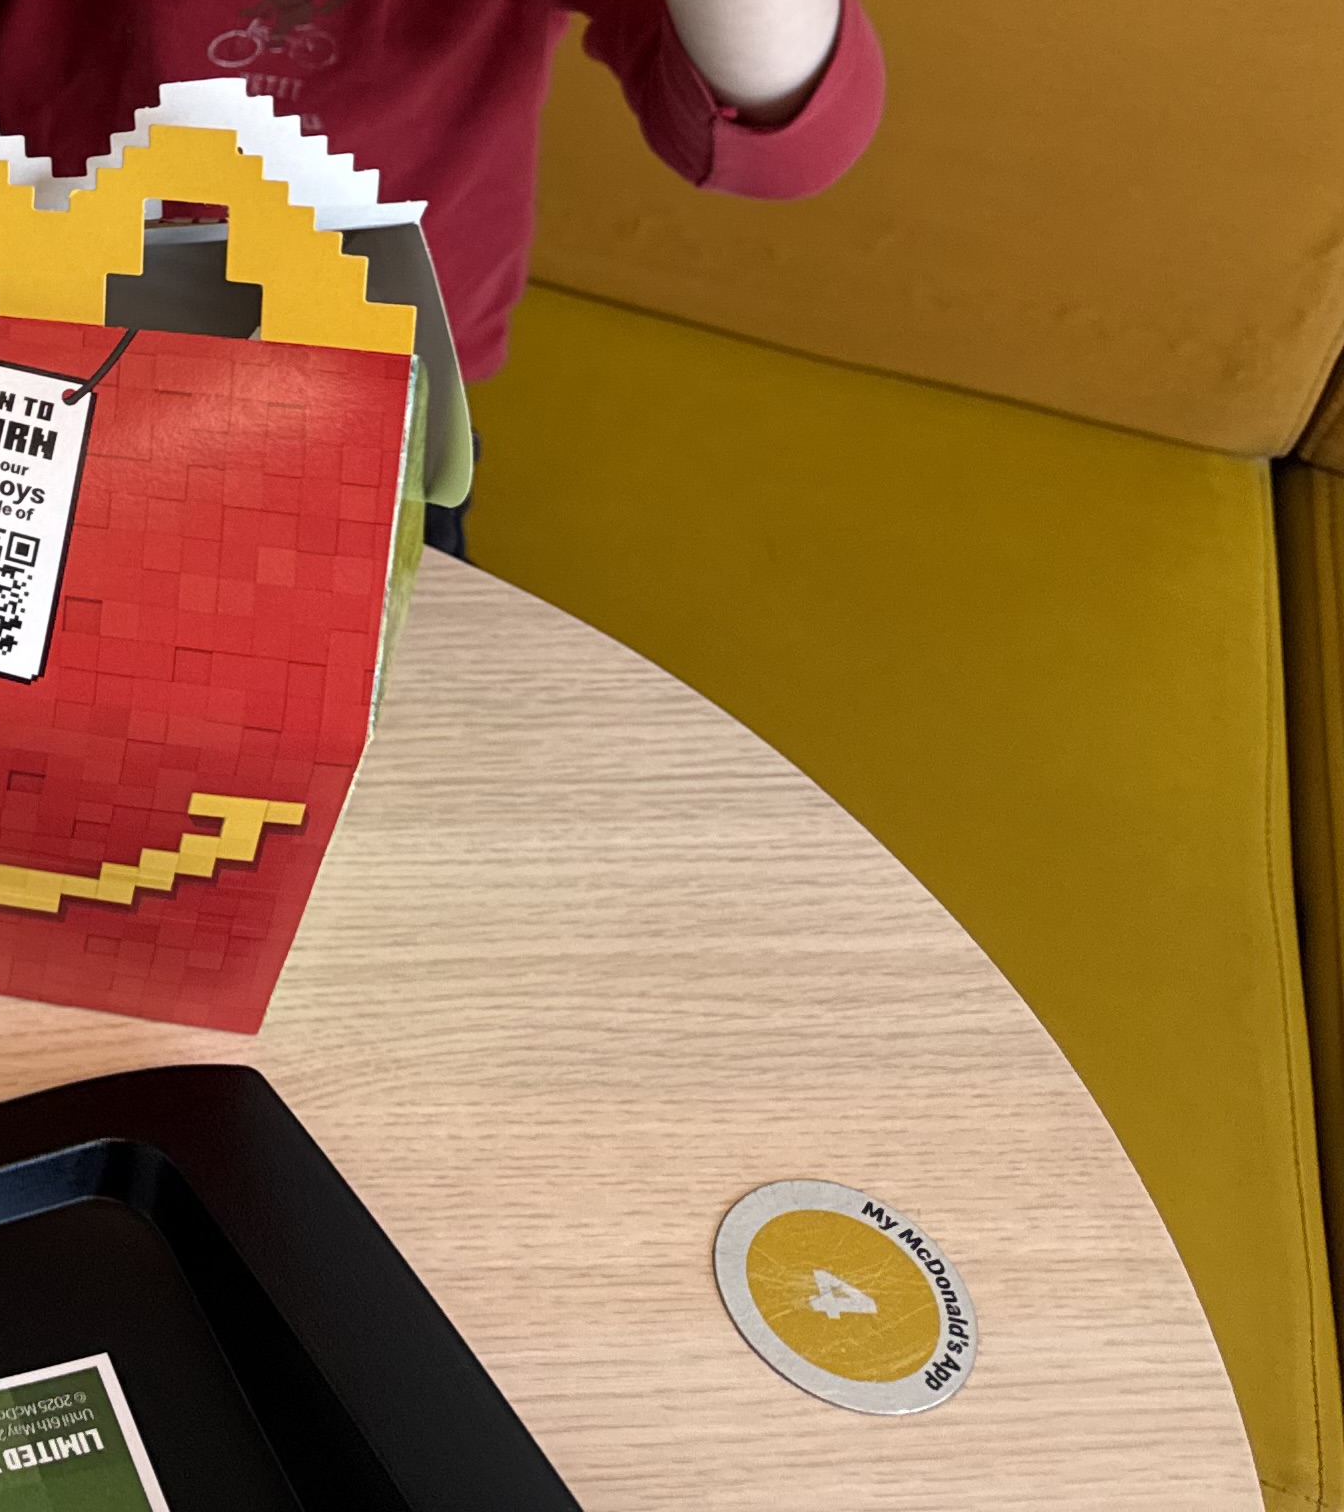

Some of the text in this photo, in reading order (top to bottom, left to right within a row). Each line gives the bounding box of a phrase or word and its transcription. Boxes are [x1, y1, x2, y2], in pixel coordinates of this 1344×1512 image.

[24, 396, 54, 421] TO
[0, 461, 29, 476] our
[15, 508, 35, 521] of
[808, 1268, 878, 1319] 4
[861, 1201, 969, 1391] My McDonald's App
[37, 1393, 73, 1412] 2025
[7, 1419, 36, 1437] May
[36, 1413, 61, 1431] 6th
[62, 1408, 94, 1429] Until
[3, 1428, 105, 1470] LIMITED
